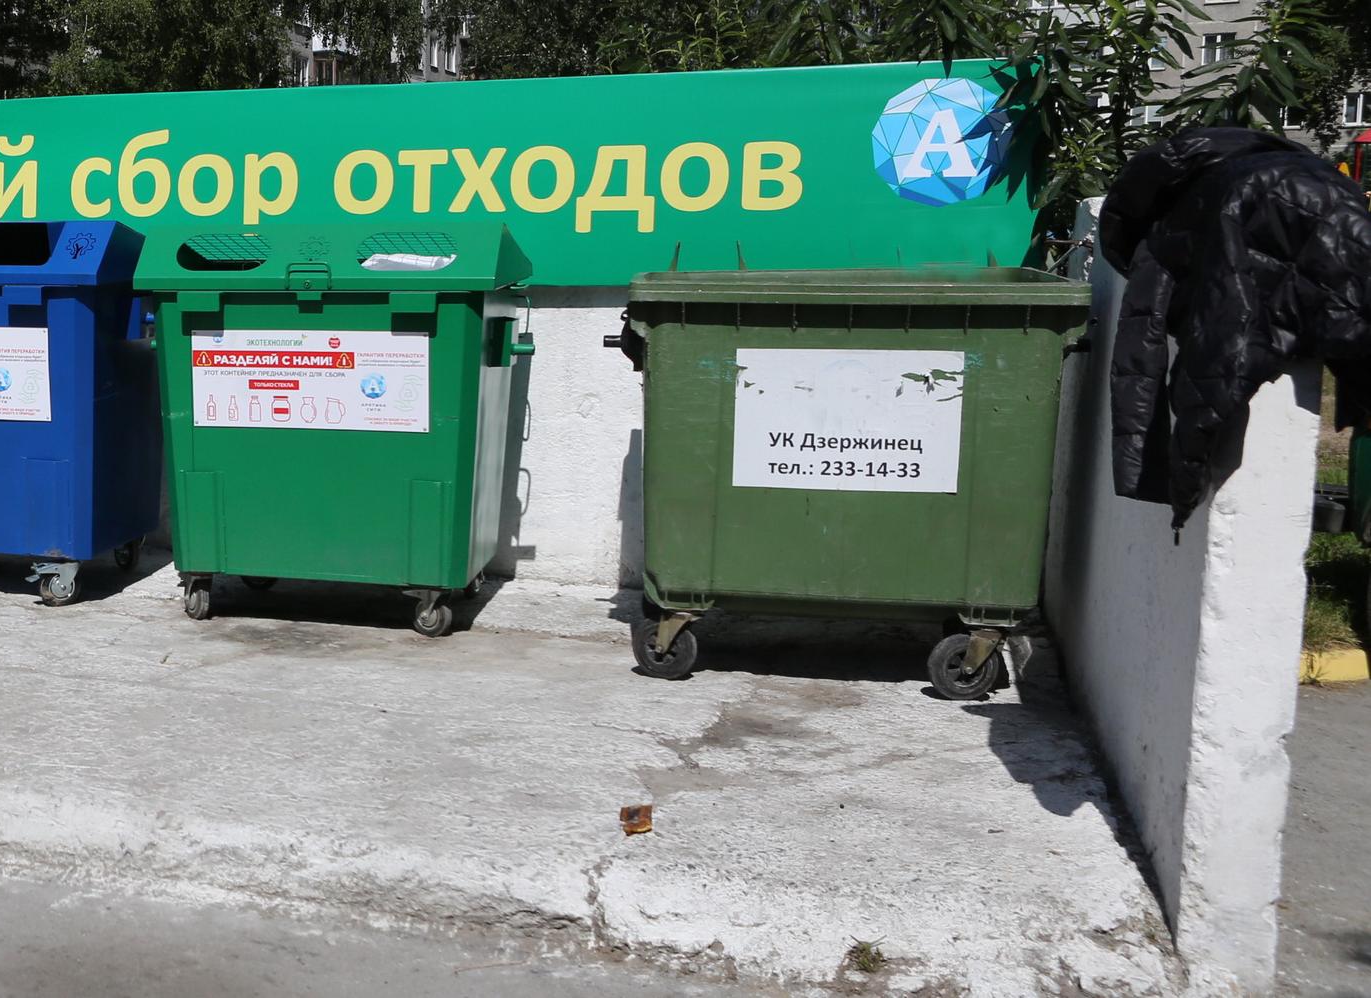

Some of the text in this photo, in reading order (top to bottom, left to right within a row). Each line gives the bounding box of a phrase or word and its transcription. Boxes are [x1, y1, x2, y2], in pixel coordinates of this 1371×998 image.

[70, 129, 300, 226] сбор
[332, 141, 804, 233] отходов
[246, 338, 303, 347] ЭКОТЕХНОЛОГИИ
[213, 354, 332, 366] РАЗДЕЛЯЙ С НАМИ!
[768, 432, 923, 454] УК Дзержинец
[768, 460, 921, 478] тел.: 233-14-33
